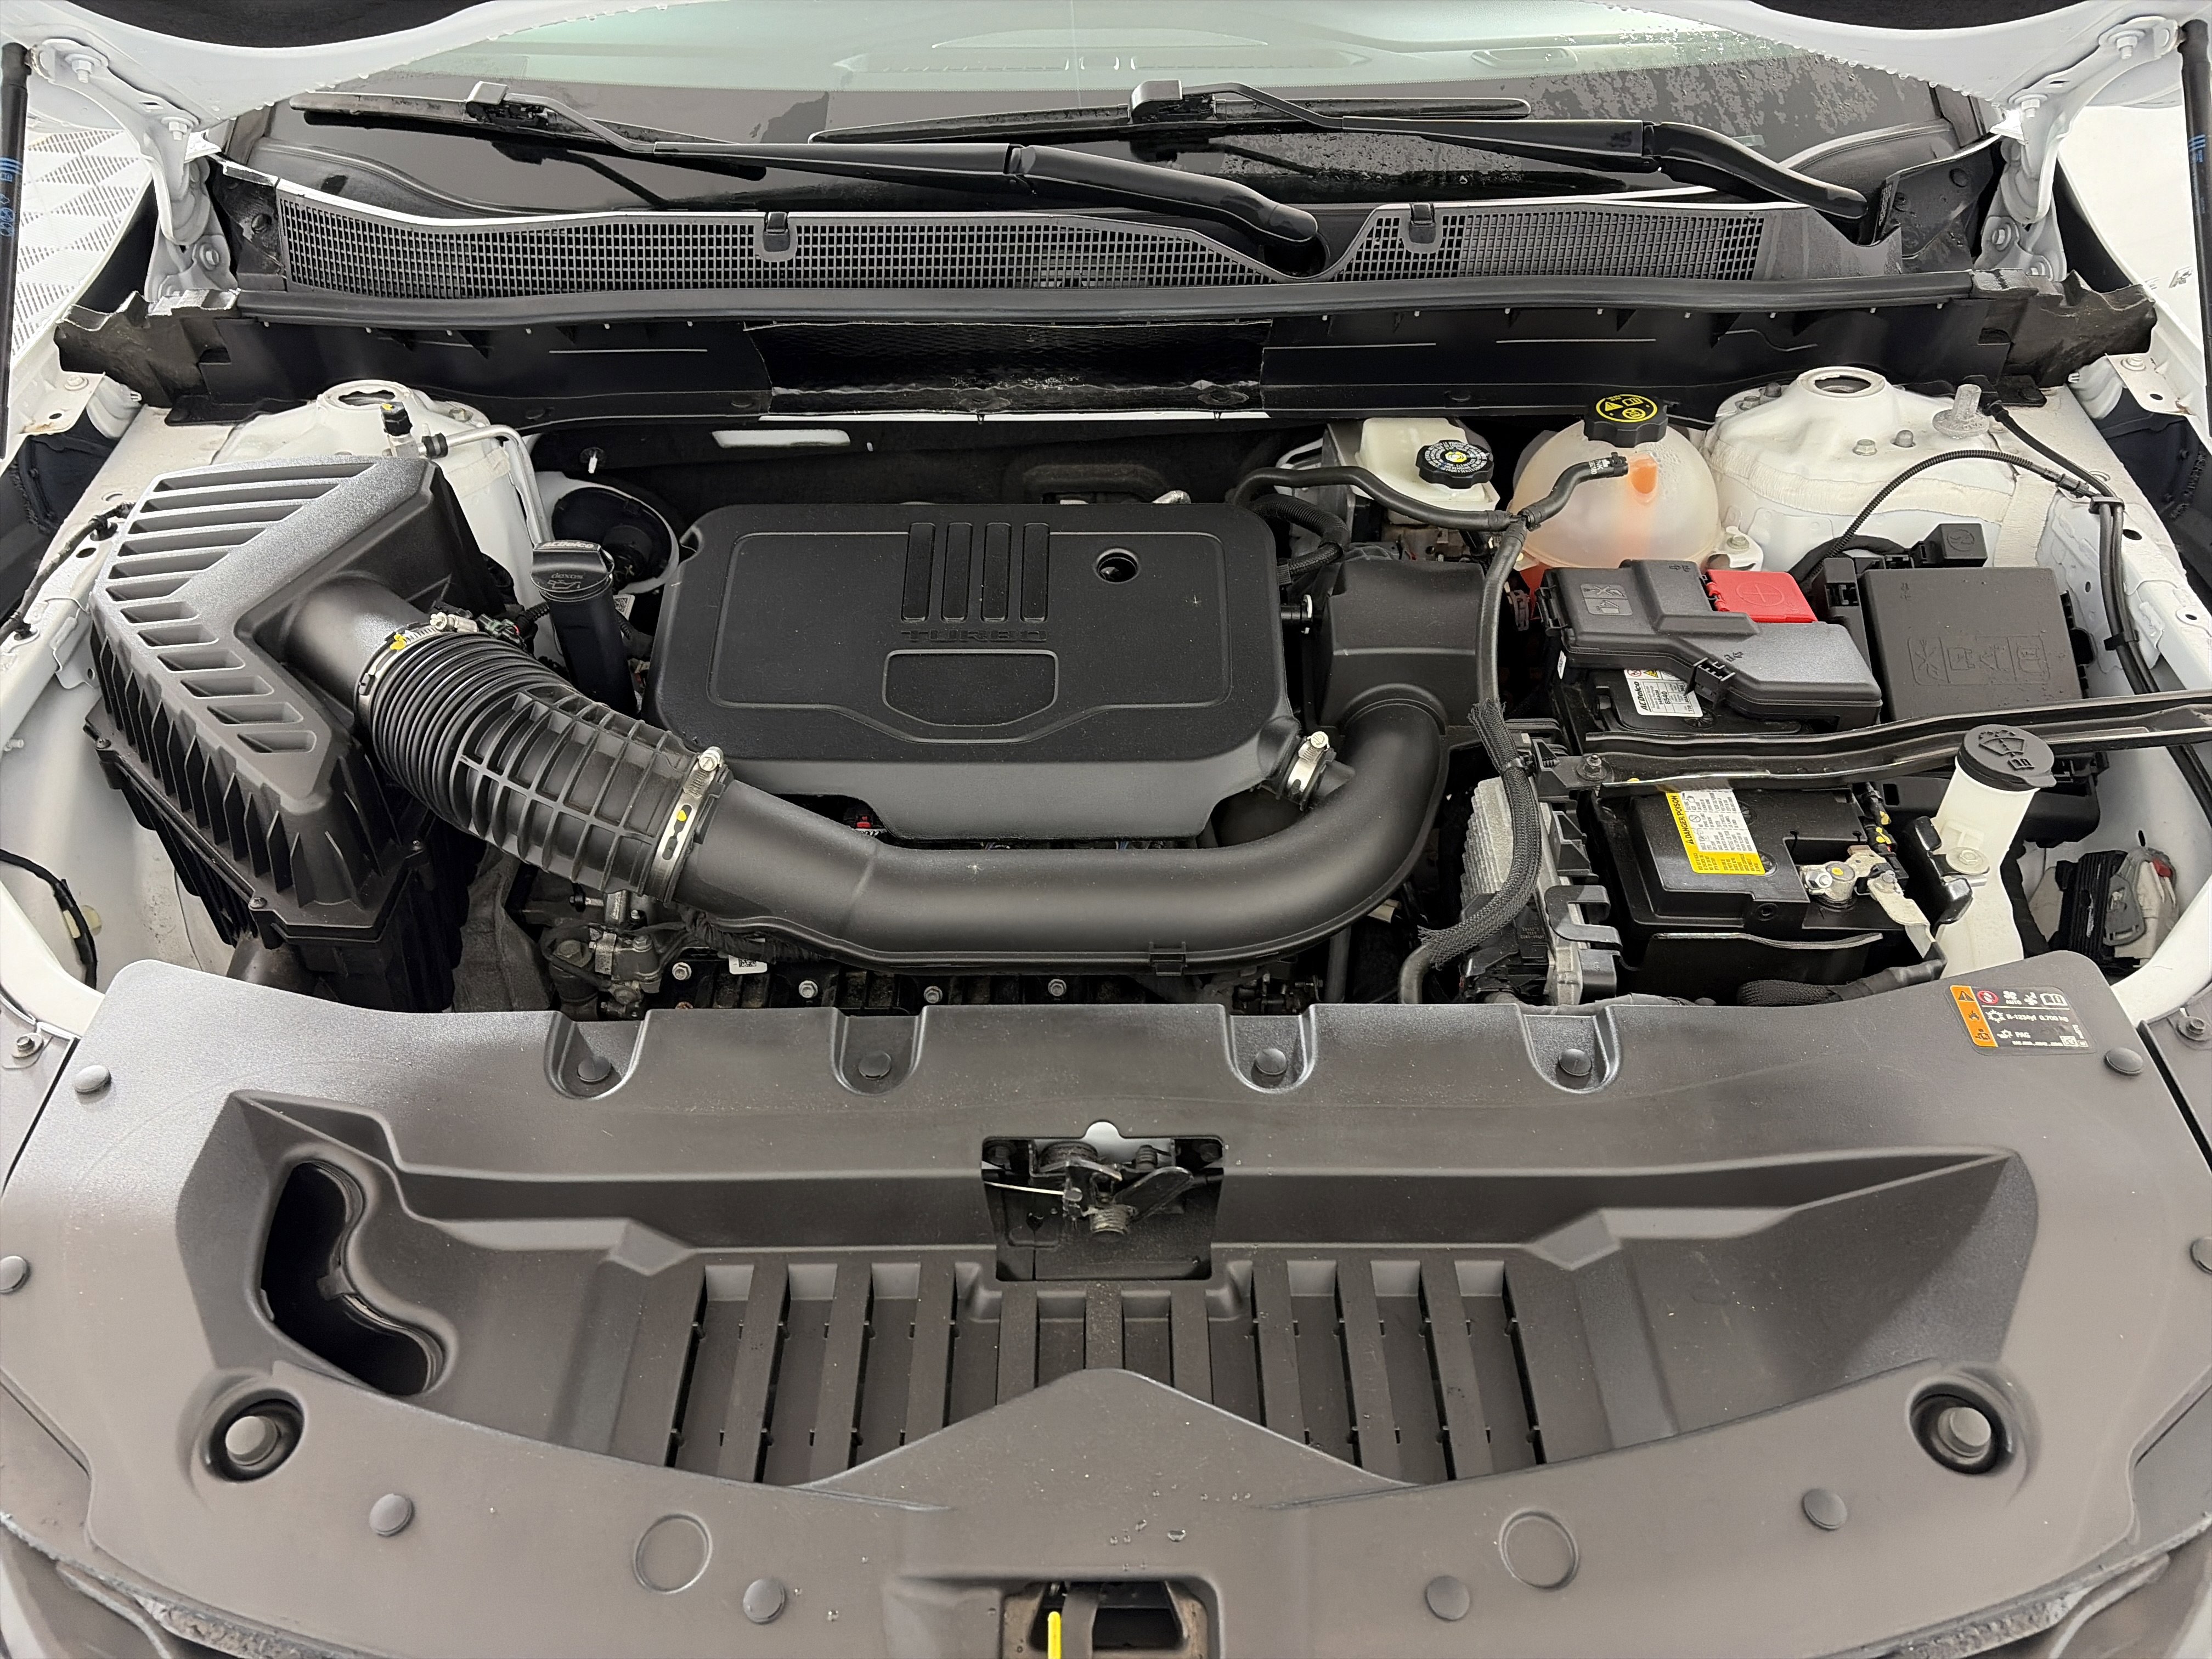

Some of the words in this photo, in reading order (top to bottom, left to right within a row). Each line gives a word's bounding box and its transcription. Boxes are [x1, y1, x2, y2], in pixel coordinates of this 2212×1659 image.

[901, 629, 1047, 642] TURBO
[1634, 681, 1649, 711] ACDelco
[1661, 691, 1671, 704] 8540
[1670, 795, 1694, 841] DANGER/POISON
